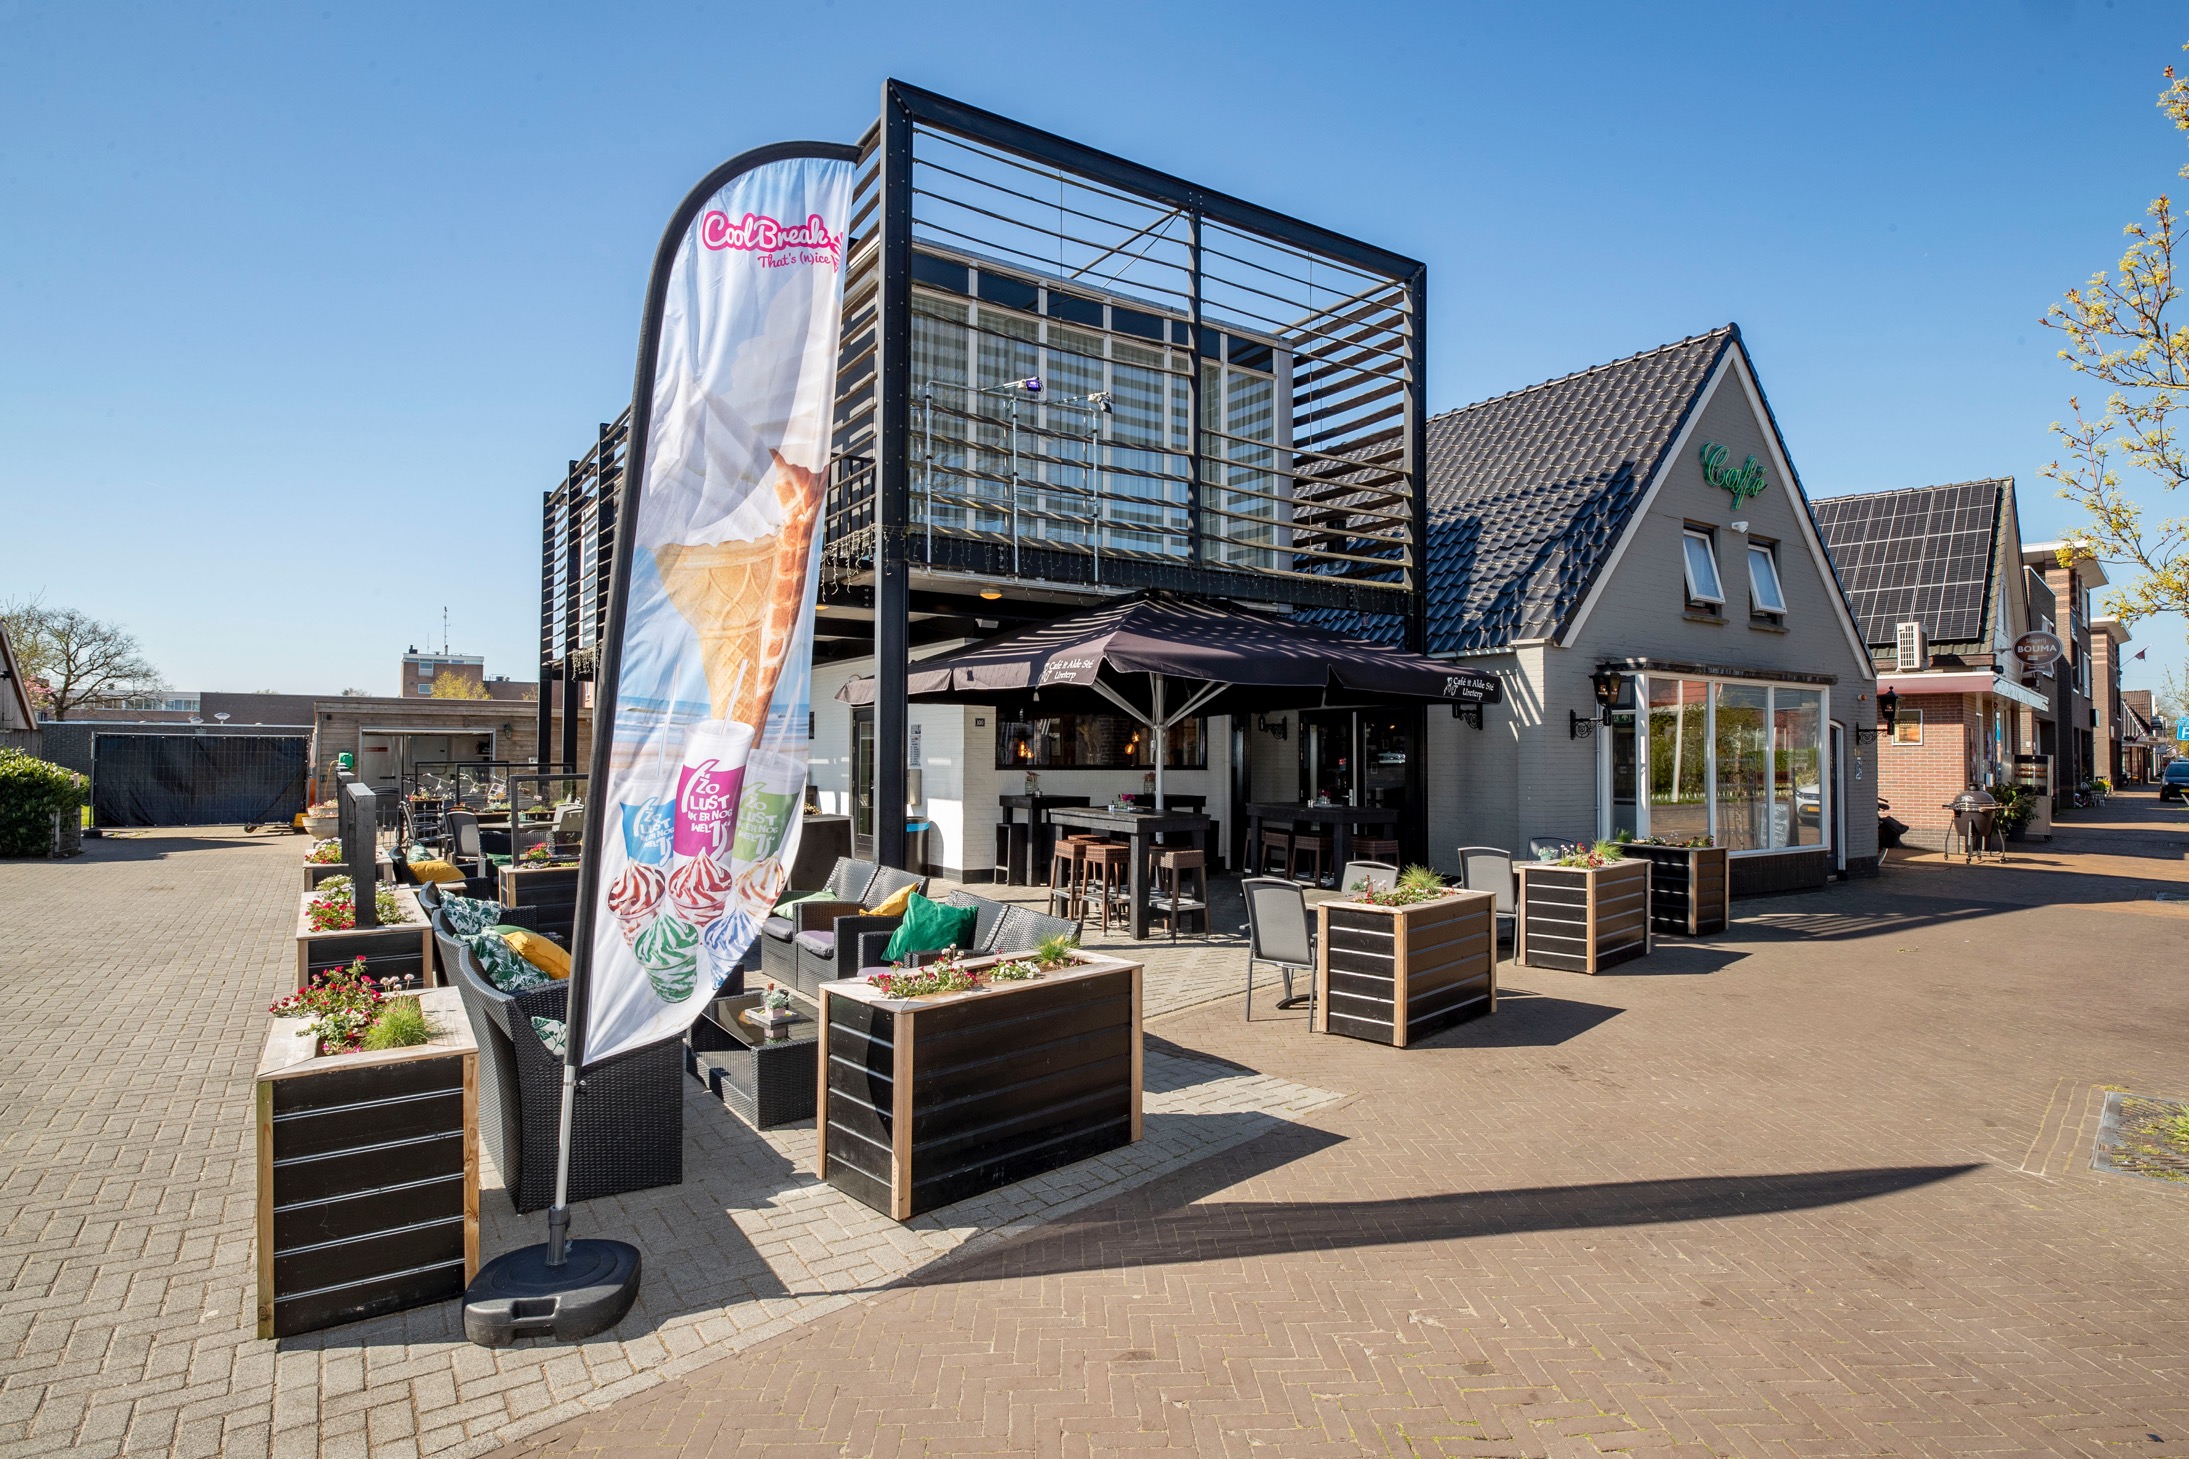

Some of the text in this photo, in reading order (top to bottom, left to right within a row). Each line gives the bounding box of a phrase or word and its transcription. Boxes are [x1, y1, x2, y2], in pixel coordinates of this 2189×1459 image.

[757, 253, 797, 268] That's
[2017, 645, 2057, 653] BOUMA
[1049, 660, 1064, 670] Café
[1453, 676, 1467, 686] Café
[1472, 679, 1485, 689] Alde
[690, 794, 730, 811] LUST
[687, 809, 733, 822] IK ER NOG
[739, 808, 777, 826] LUST
[690, 822, 711, 834] WEL
